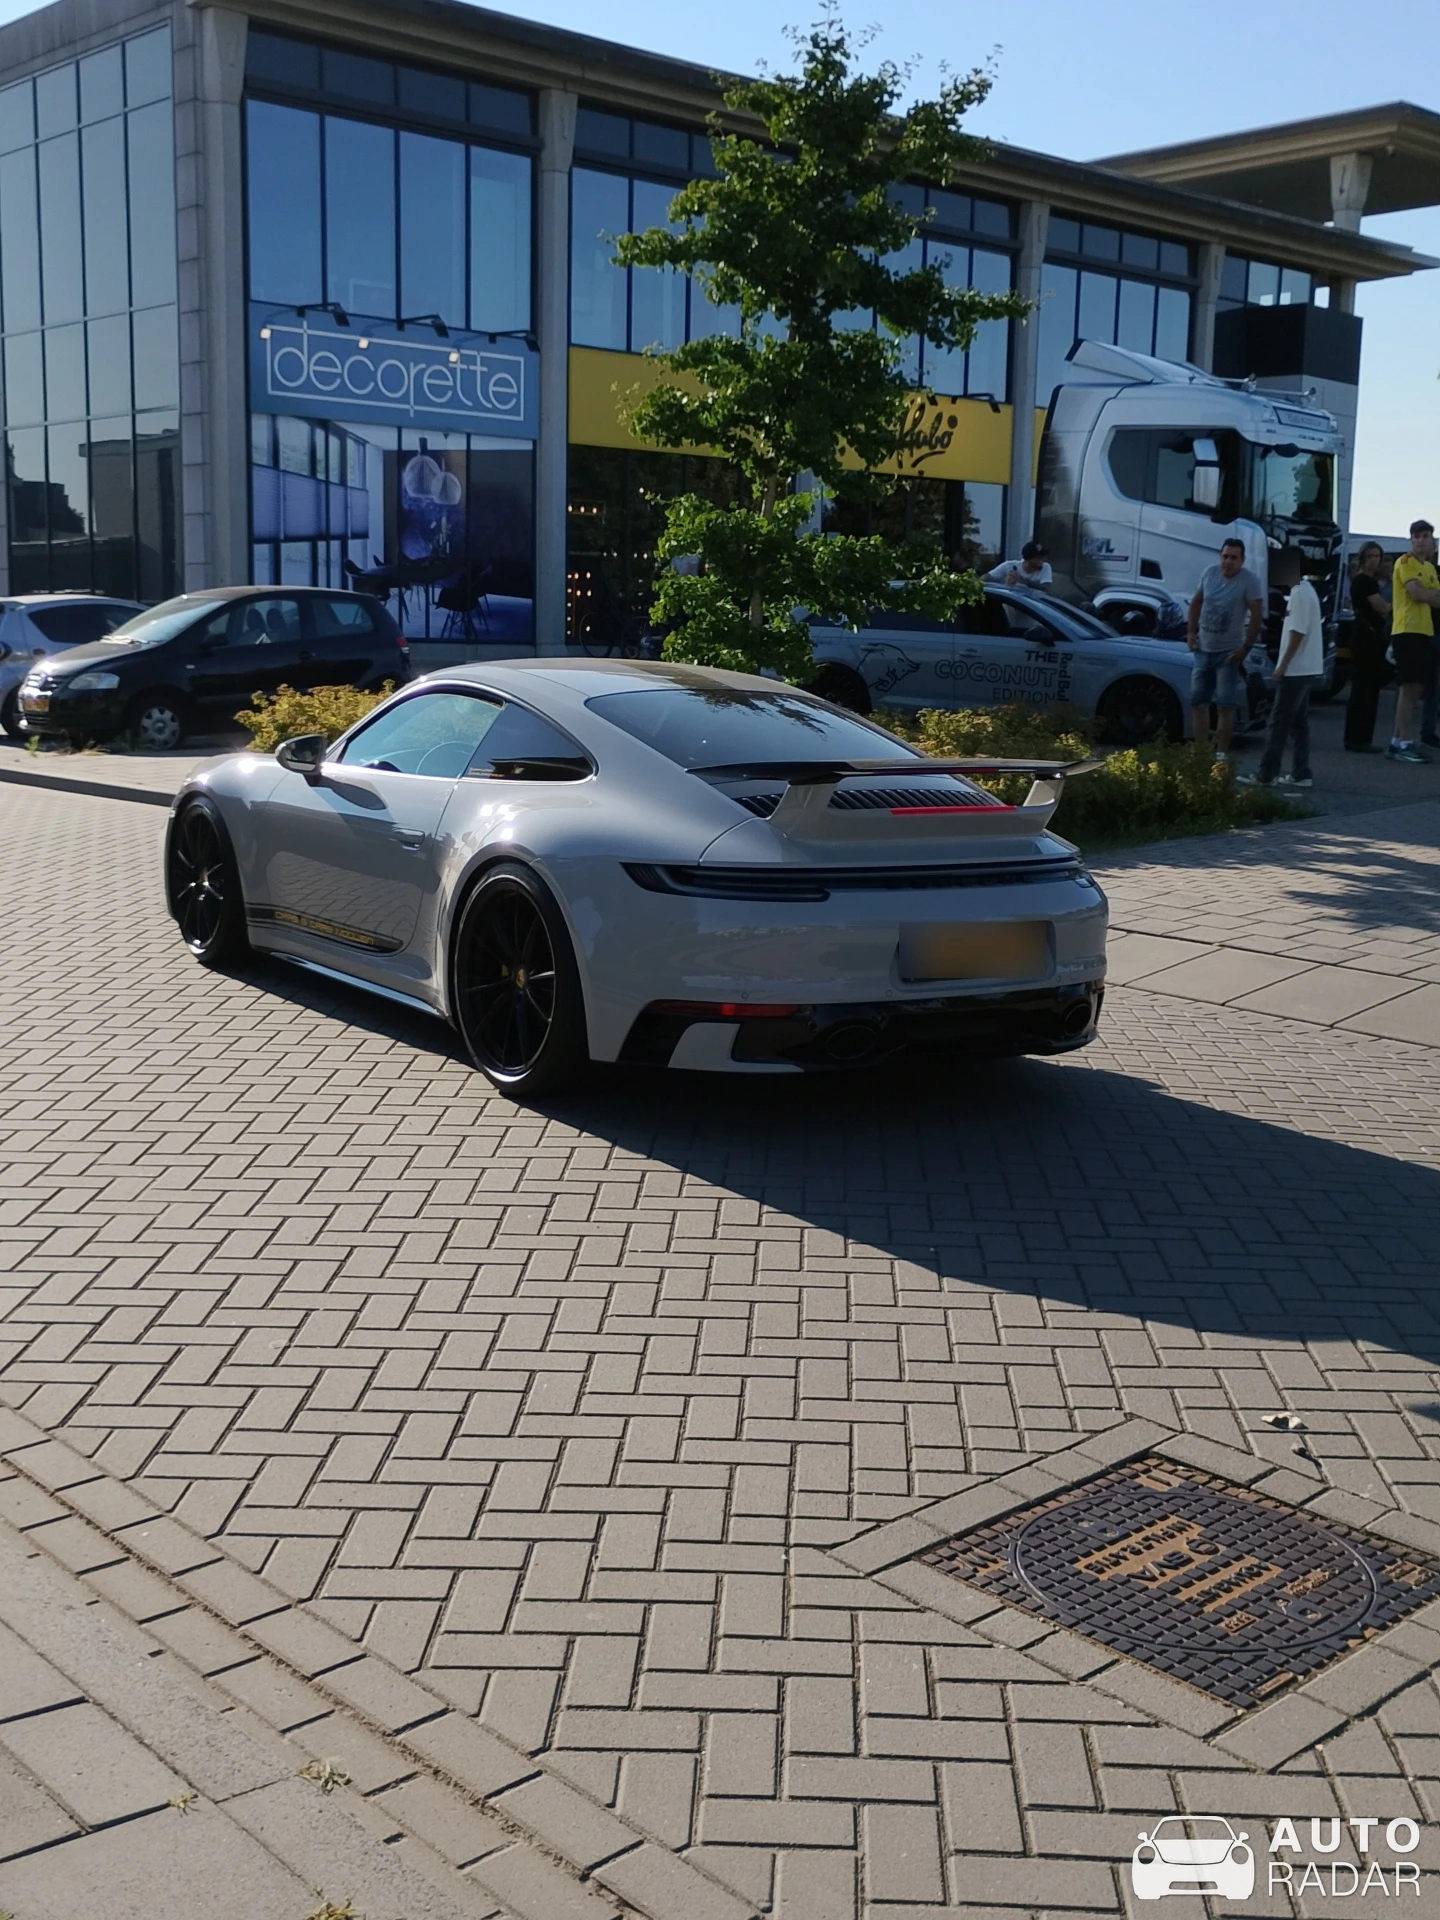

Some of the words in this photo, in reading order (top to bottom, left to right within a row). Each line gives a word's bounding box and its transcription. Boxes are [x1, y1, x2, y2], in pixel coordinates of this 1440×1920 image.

[274, 320, 518, 416] decorette
[1025, 649, 1059, 663] THE
[934, 658, 1057, 688] COCONUT
[993, 687, 1056, 704] EDITION
